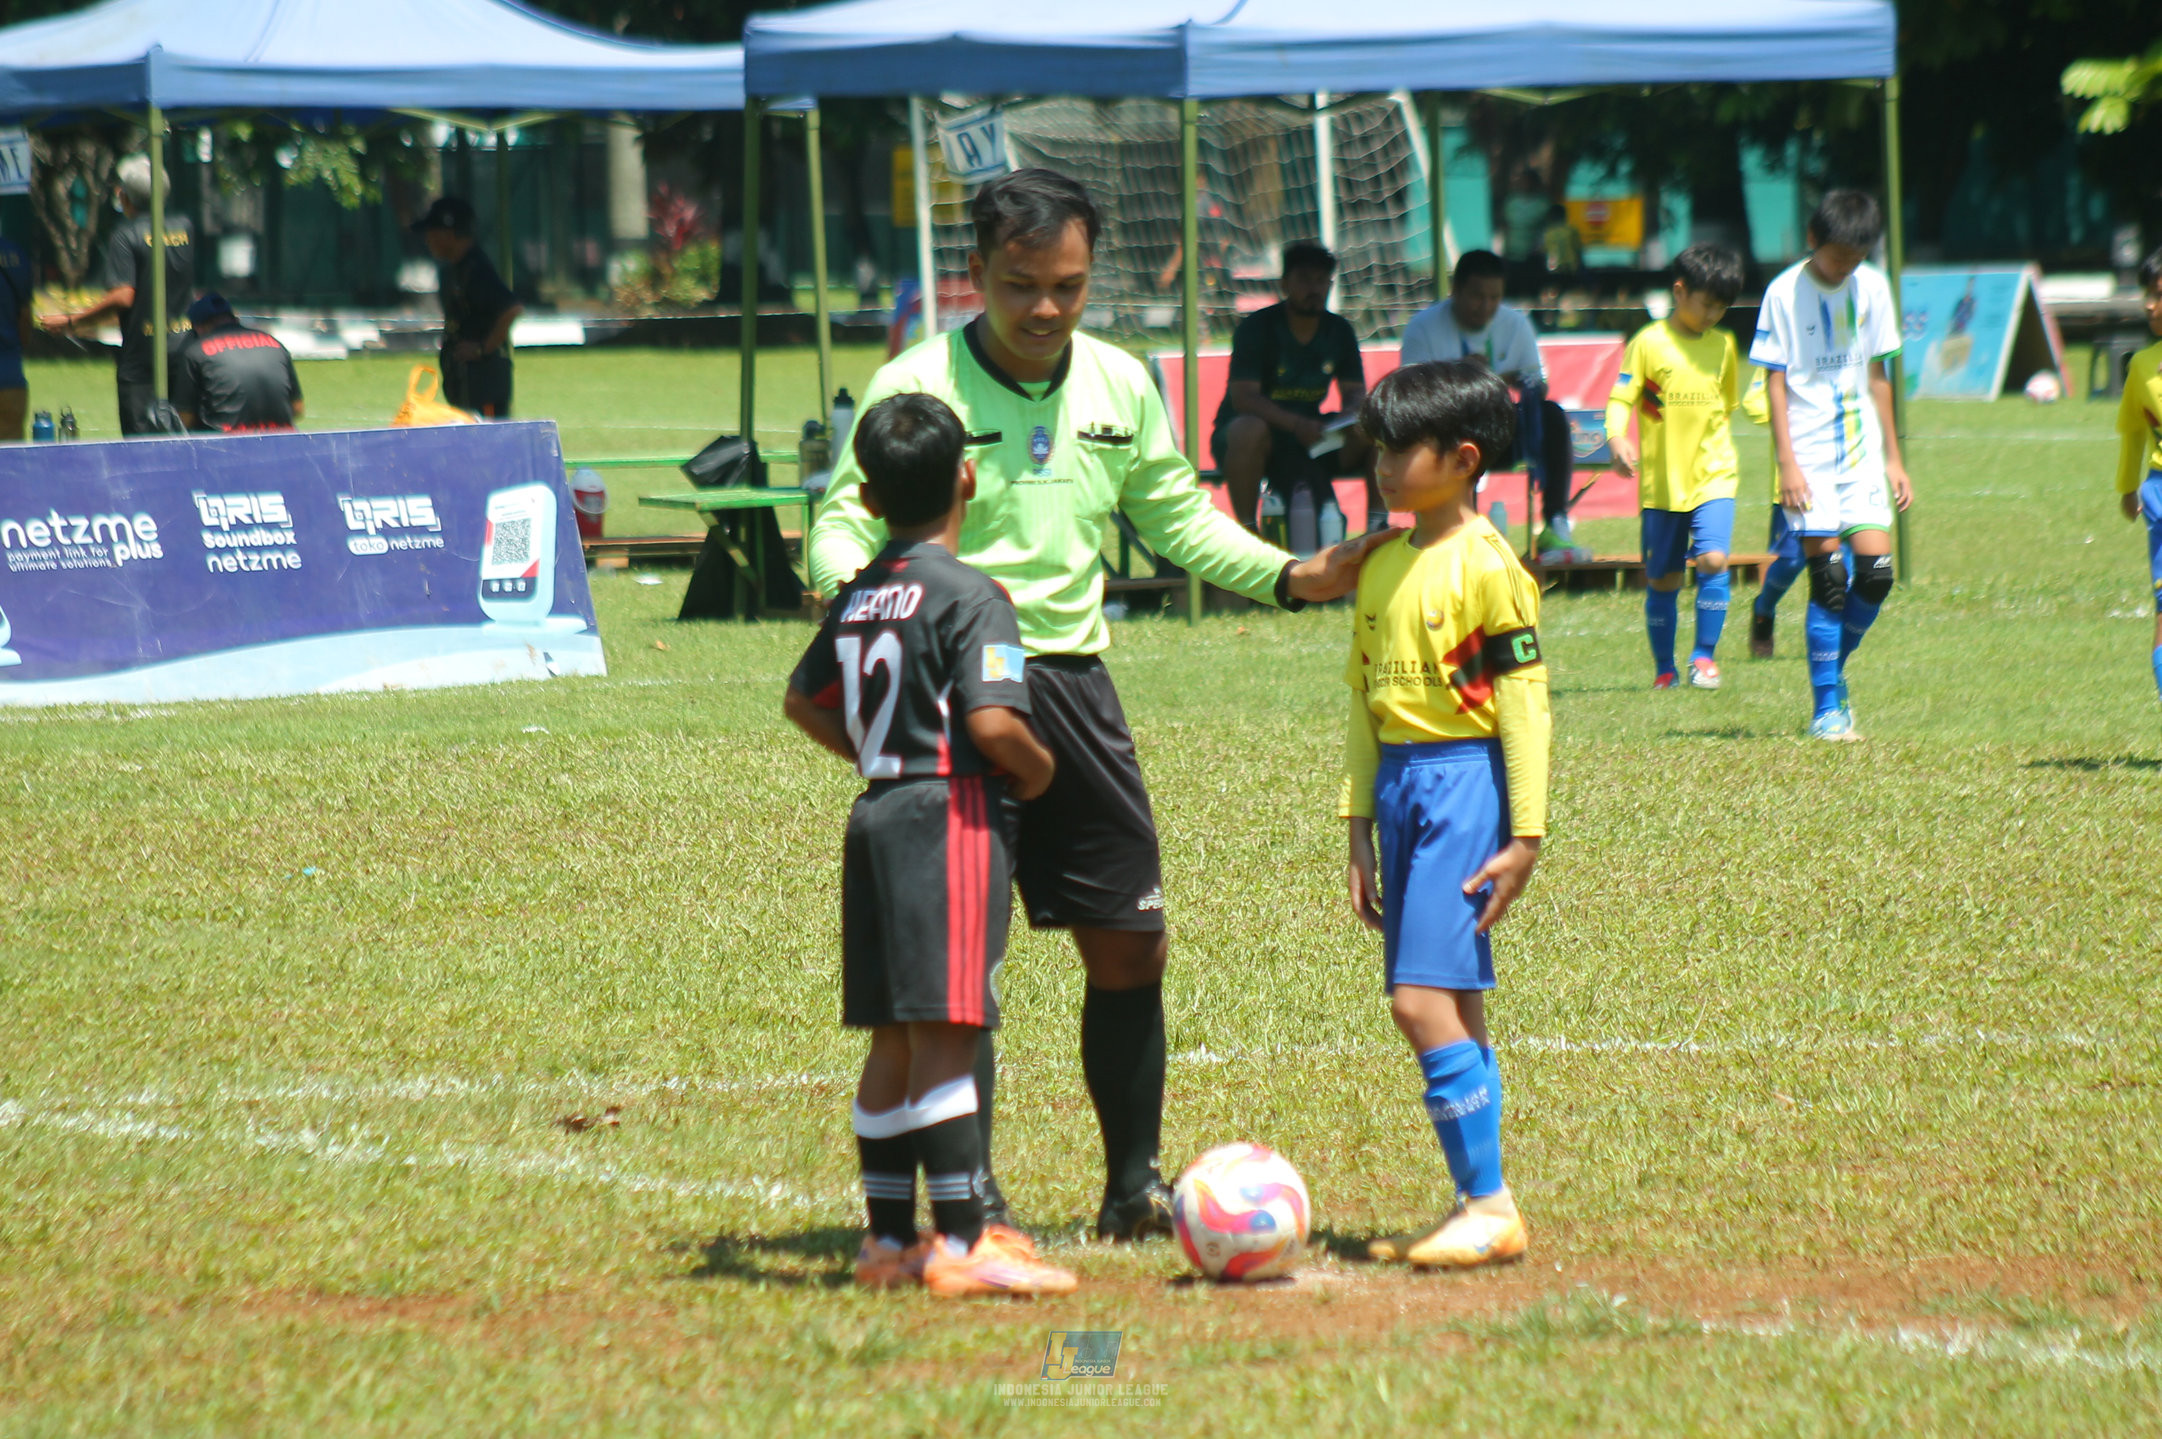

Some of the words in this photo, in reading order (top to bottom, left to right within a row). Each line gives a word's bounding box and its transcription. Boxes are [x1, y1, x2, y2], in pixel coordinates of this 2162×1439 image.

[944, 121, 997, 169] AY
[201, 332, 281, 357] OFFICIAL
[199, 493, 289, 532] QRIS
[342, 495, 438, 536] QRIS
[1, 507, 158, 549] netzme
[7, 548, 60, 563] payment
[62, 546, 88, 559] link
[112, 540, 164, 567] plus
[353, 537, 385, 552] toko
[388, 534, 445, 551] netzme
[8, 560, 58, 572] ultimate
[60, 557, 112, 570] solutions
[206, 547, 303, 574] netzme
[1511, 633, 1537, 664] C
[835, 629, 902, 779] 12
